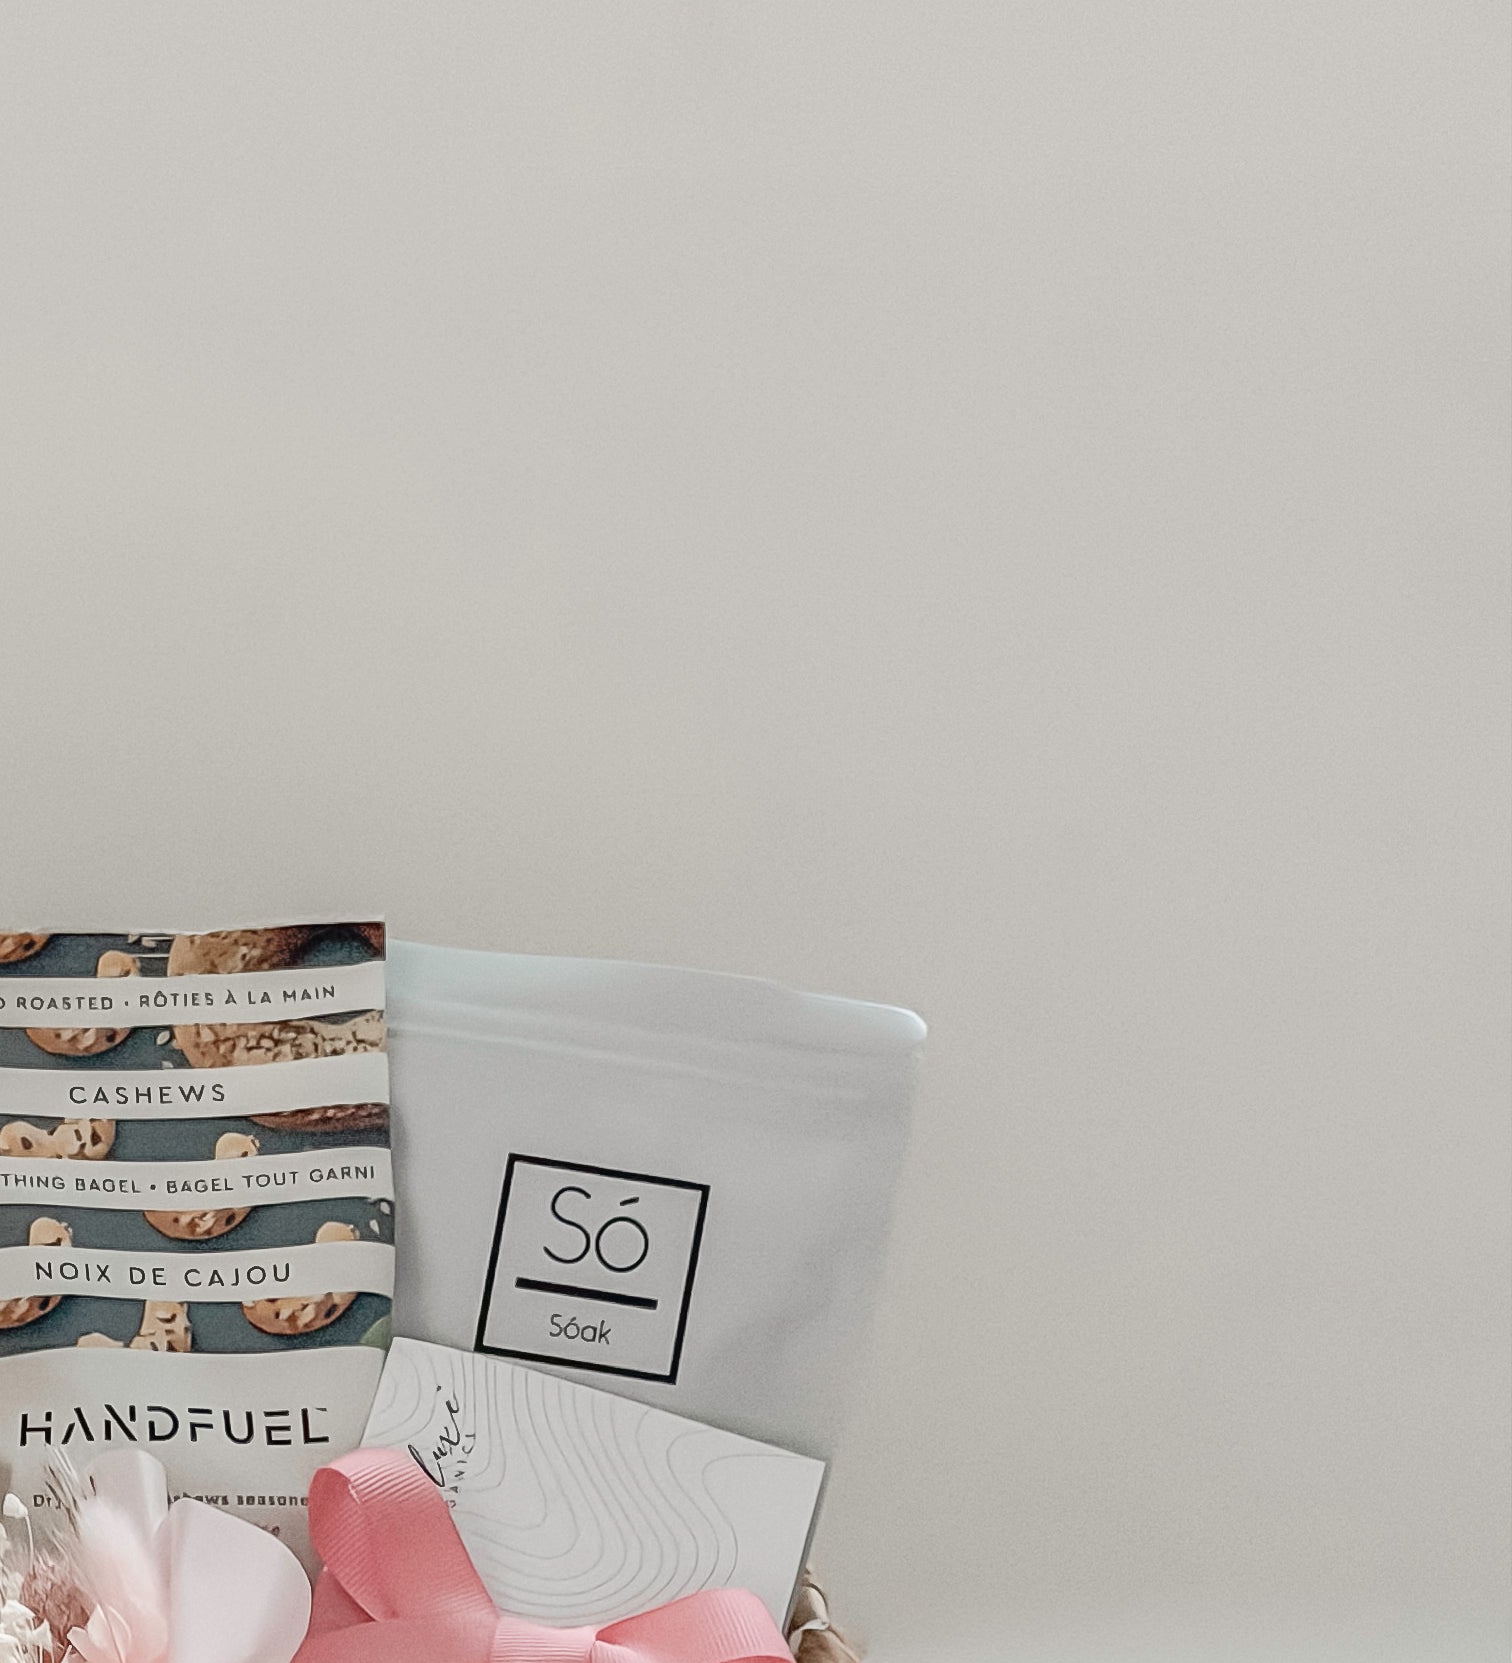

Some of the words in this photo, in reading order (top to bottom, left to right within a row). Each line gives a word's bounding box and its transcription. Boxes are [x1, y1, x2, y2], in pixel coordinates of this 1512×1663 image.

[16, 996, 113, 1011] ROASTED
[139, 990, 214, 1008] RÔTIES
[224, 989, 238, 1005] À
[248, 990, 272, 1005] LA
[283, 985, 335, 1003] MAIN
[69, 1083, 225, 1105] CASHEWS
[75, 1177, 142, 1194] BAGEL
[166, 1177, 234, 1194] BAGEL
[241, 1171, 299, 1189] TOUT
[309, 1165, 375, 1183] GARNI
[543, 1186, 649, 1273] Só
[35, 1261, 111, 1283] NOIX
[129, 1266, 167, 1286] DE
[184, 1262, 290, 1287] CAJOU
[549, 1313, 612, 1345] Sóak
[20, 1404, 329, 1446] HANDFUEL
[237, 1494, 309, 1507] seasone
